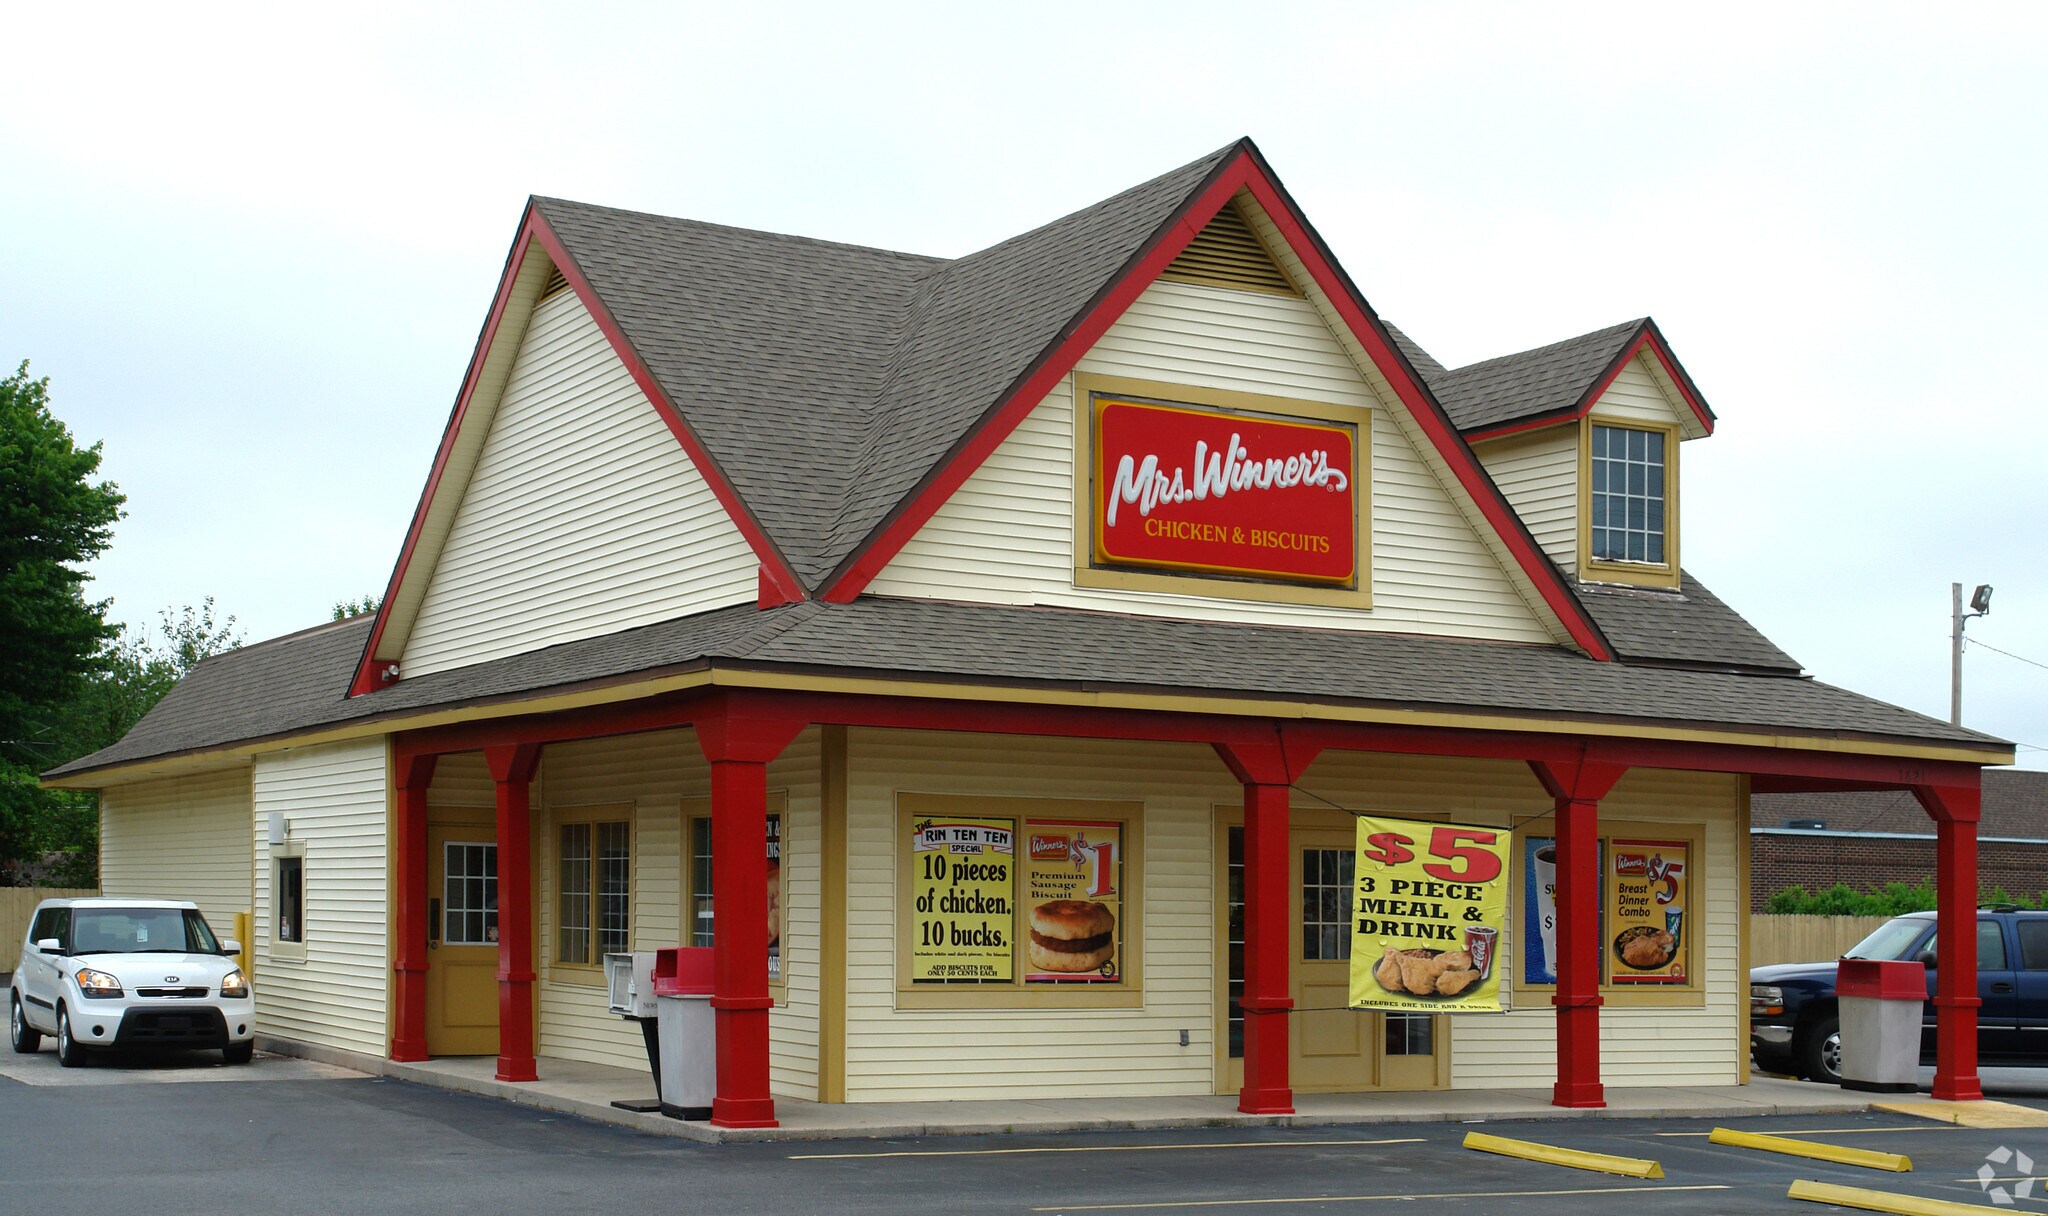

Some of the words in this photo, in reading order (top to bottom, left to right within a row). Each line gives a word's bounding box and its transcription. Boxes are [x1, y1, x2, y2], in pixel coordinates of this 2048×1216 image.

[1107, 454, 1193, 527] Mrs.
[1194, 432, 1348, 500] Winner's
[1145, 518, 1227, 544] CHICKEN
[1232, 528, 1245, 545] &
[1250, 530, 1330, 553] BISCUITS
[915, 819, 934, 832] THE
[953, 830, 977, 841] TEN
[984, 831, 1008, 844] TEN
[1364, 827, 1502, 883] $5
[924, 854, 946, 880] 10
[952, 856, 1007, 886] pieces
[1031, 872, 1086, 880] Premium
[1030, 880, 1077, 890] Sausage
[1031, 890, 1072, 898] Biscuit
[1360, 877, 1376, 892] 3
[1390, 879, 1482, 901] PIECE
[1618, 883, 1648, 894] Breast
[916, 887, 935, 912] of
[940, 888, 1011, 915] chicken.
[1360, 898, 1448, 920] MEAL
[1462, 906, 1483, 922] &
[1618, 895, 1649, 905] Dinner
[1618, 906, 1650, 916] Combo
[922, 920, 944, 946] 10
[950, 920, 1007, 947] bucks.
[1357, 918, 1457, 940] DRINK
